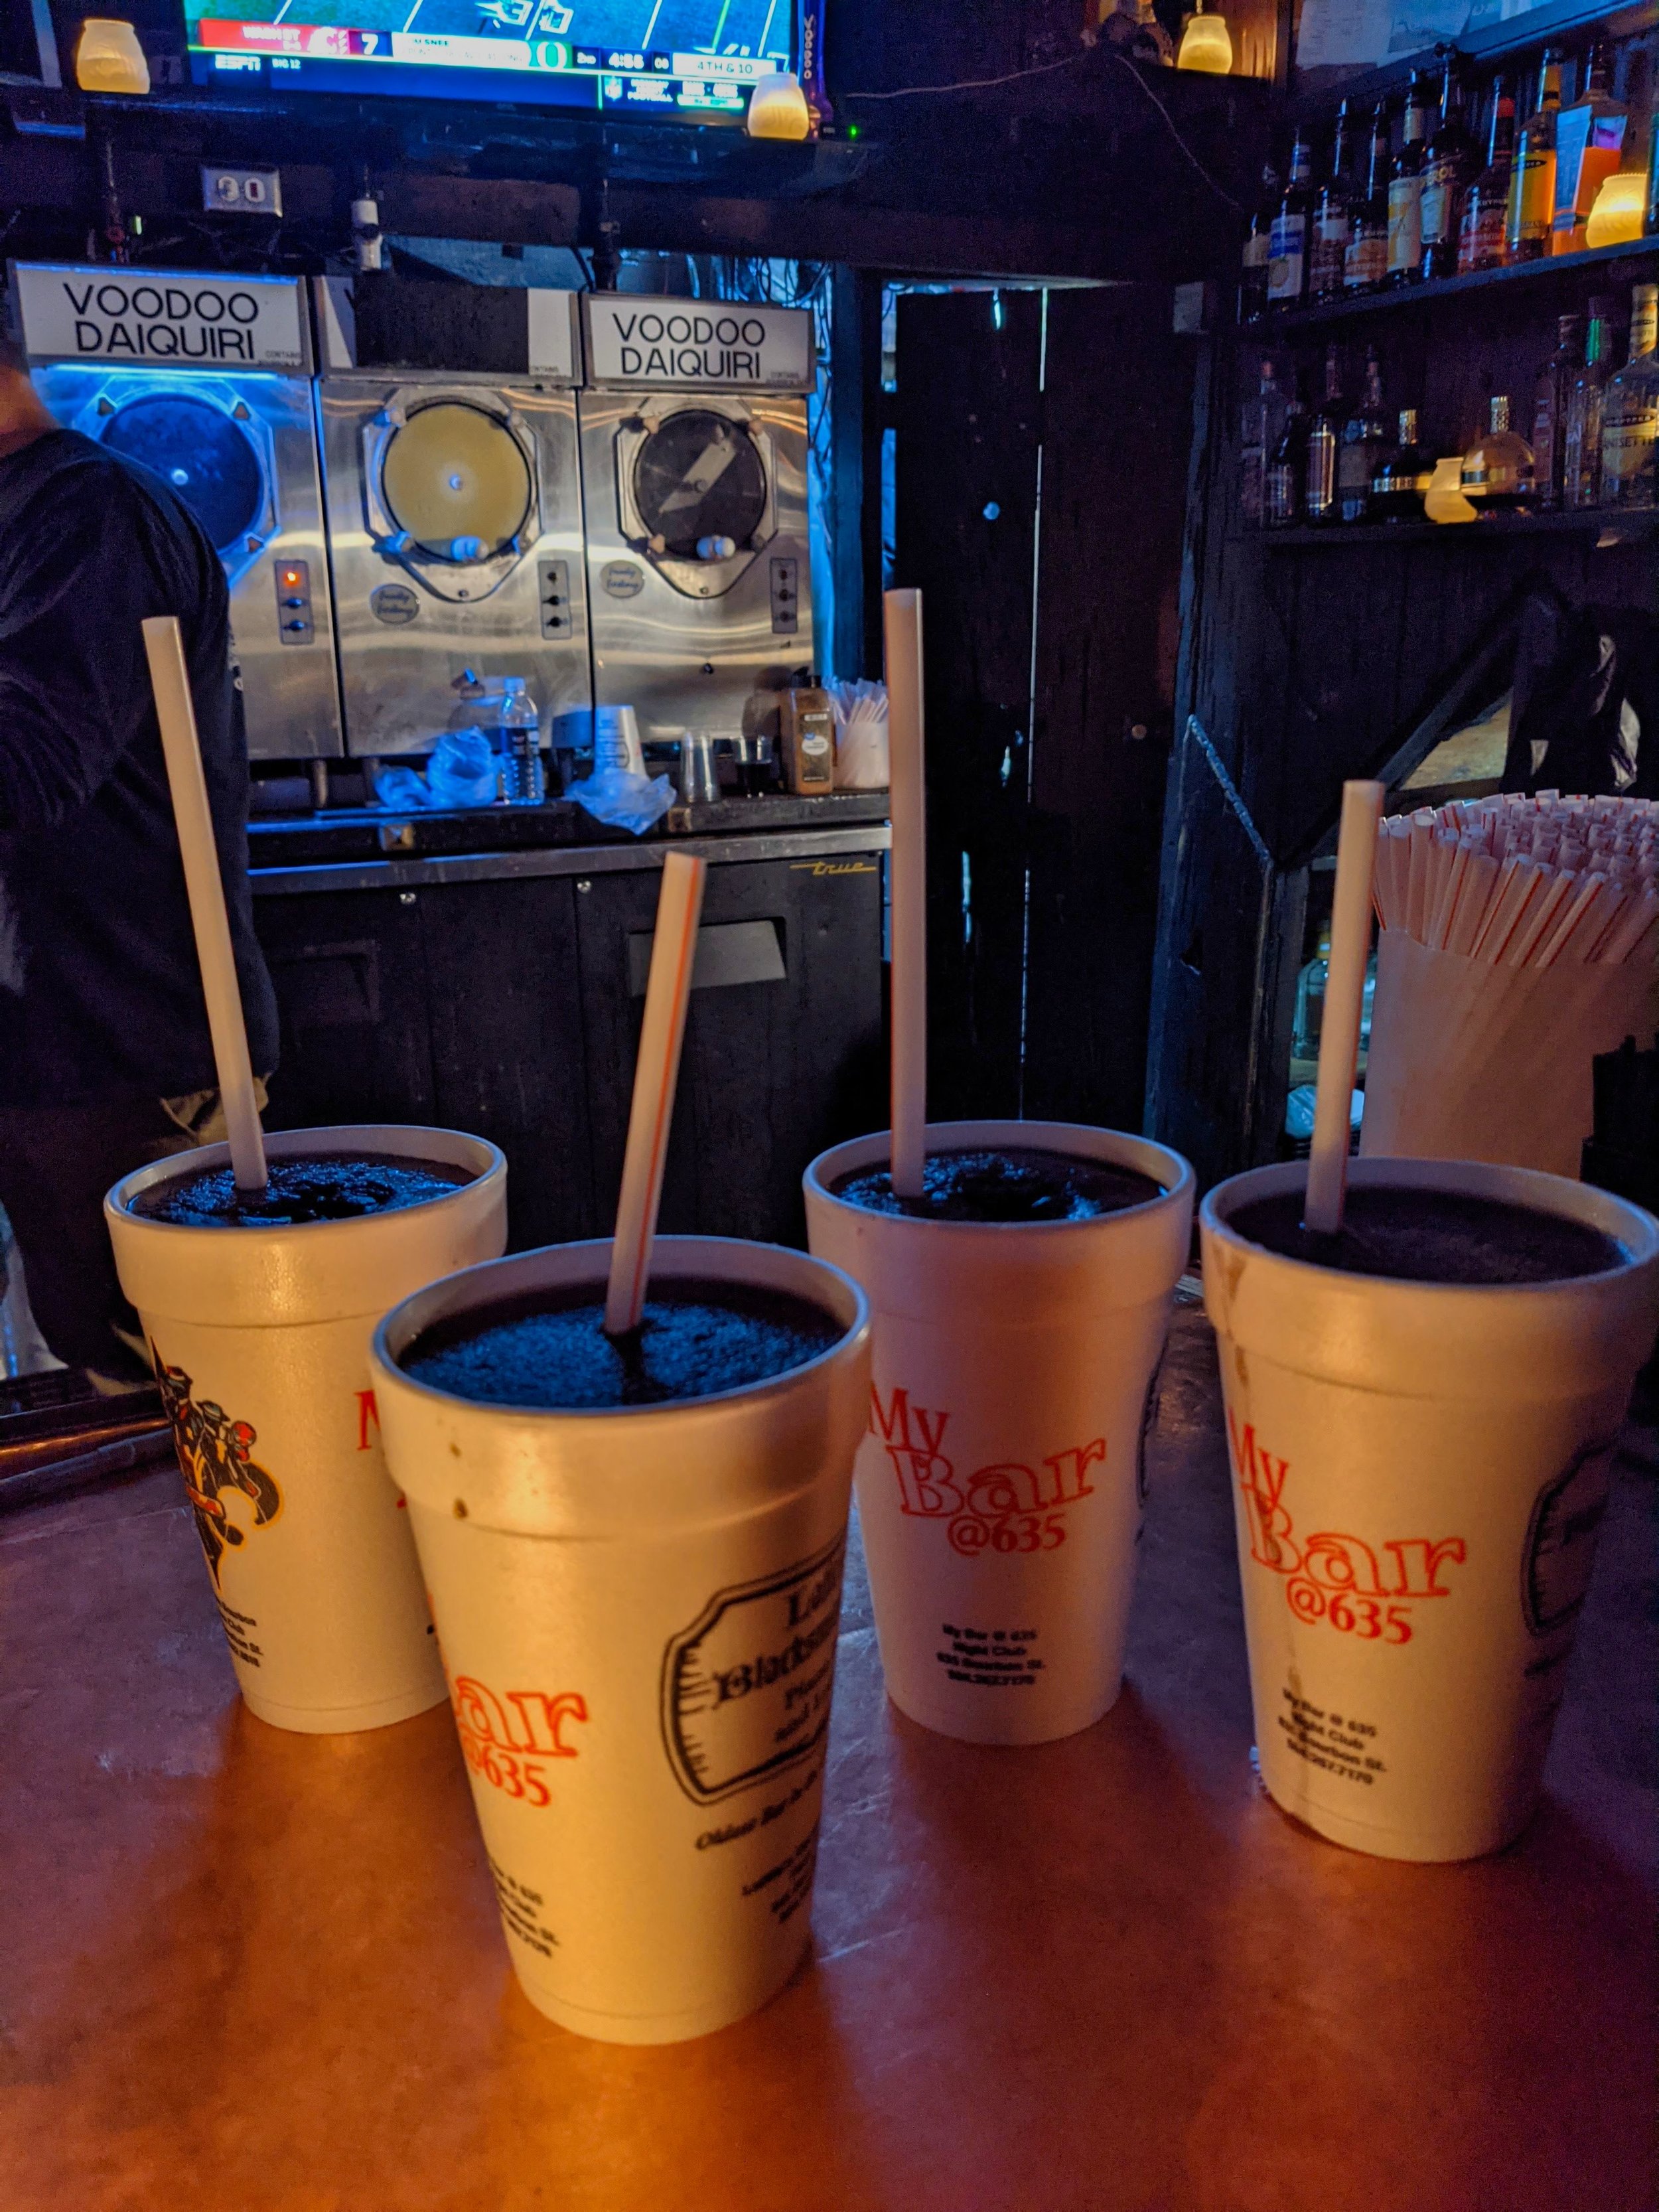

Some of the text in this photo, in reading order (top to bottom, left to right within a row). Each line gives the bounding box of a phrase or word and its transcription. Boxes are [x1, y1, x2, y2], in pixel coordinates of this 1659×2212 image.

[215, 54, 261, 71] ESPN
[361, 33, 379, 55] 7
[697, 61, 753, 74] 4TH & 10
[63, 283, 259, 324] VOODOO
[74, 320, 255, 360] DAIQUIRI
[612, 313, 765, 347] VOODOO
[620, 347, 760, 379] DAIQUIRI
[790, 861, 876, 877] true
[885, 1438, 1107, 1518] Bar
[947, 1512, 1067, 1556] @635
[1240, 1483, 1467, 1597] Bar
[1285, 1576, 1413, 1646] @635
